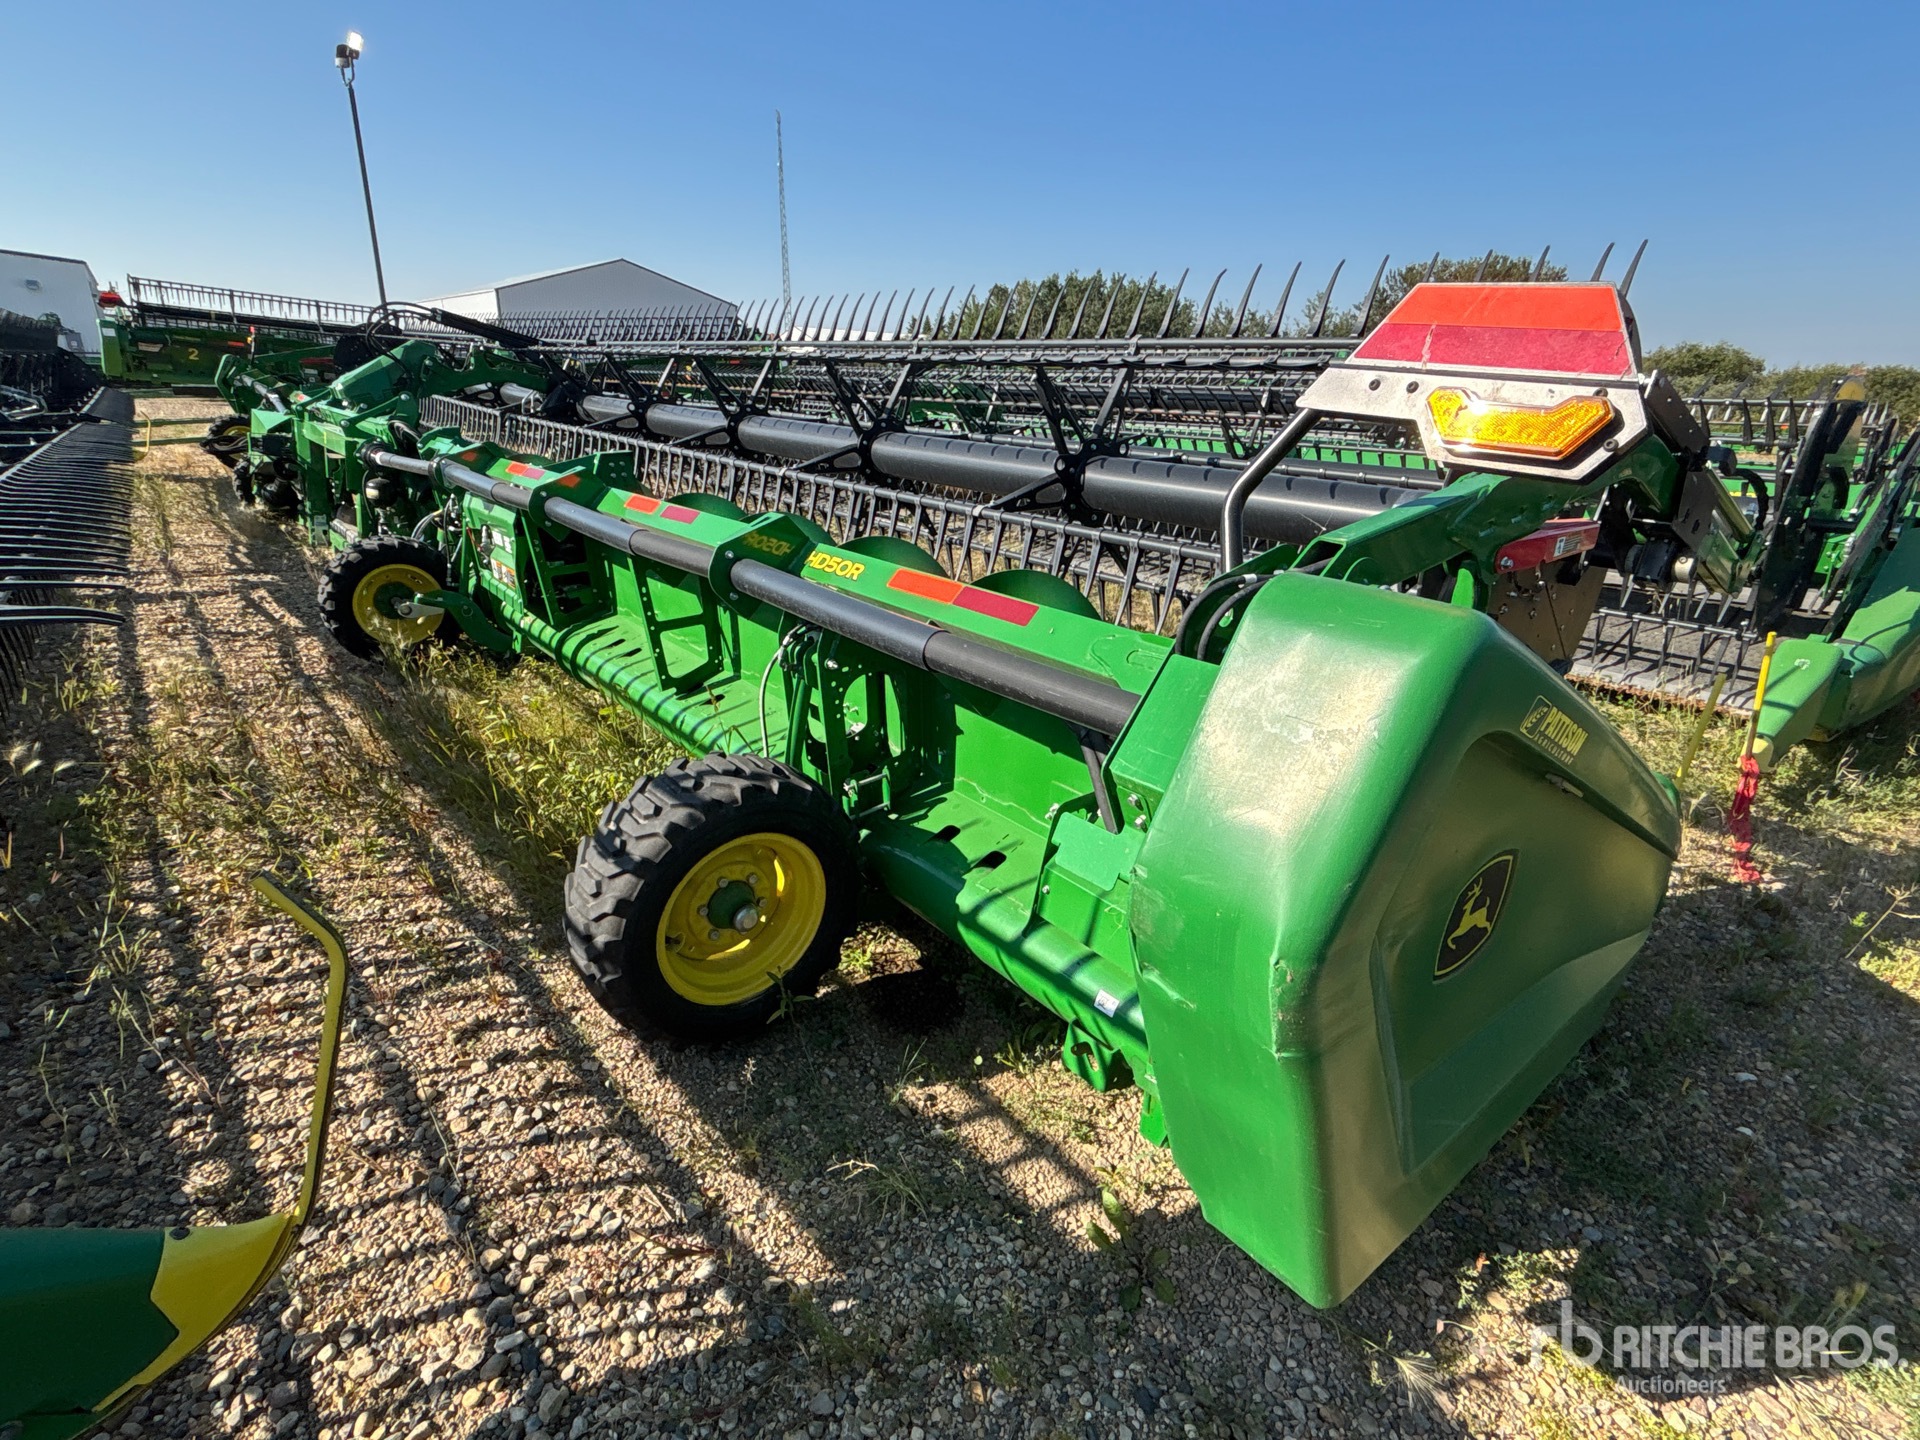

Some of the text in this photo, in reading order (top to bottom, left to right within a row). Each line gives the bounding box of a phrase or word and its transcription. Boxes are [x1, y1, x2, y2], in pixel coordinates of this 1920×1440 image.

[188, 347, 200, 360] 2
[804, 550, 865, 581] HD50R
[1540, 706, 1589, 756] PATTISON
[1533, 733, 1574, 765] AGRICULTURE
